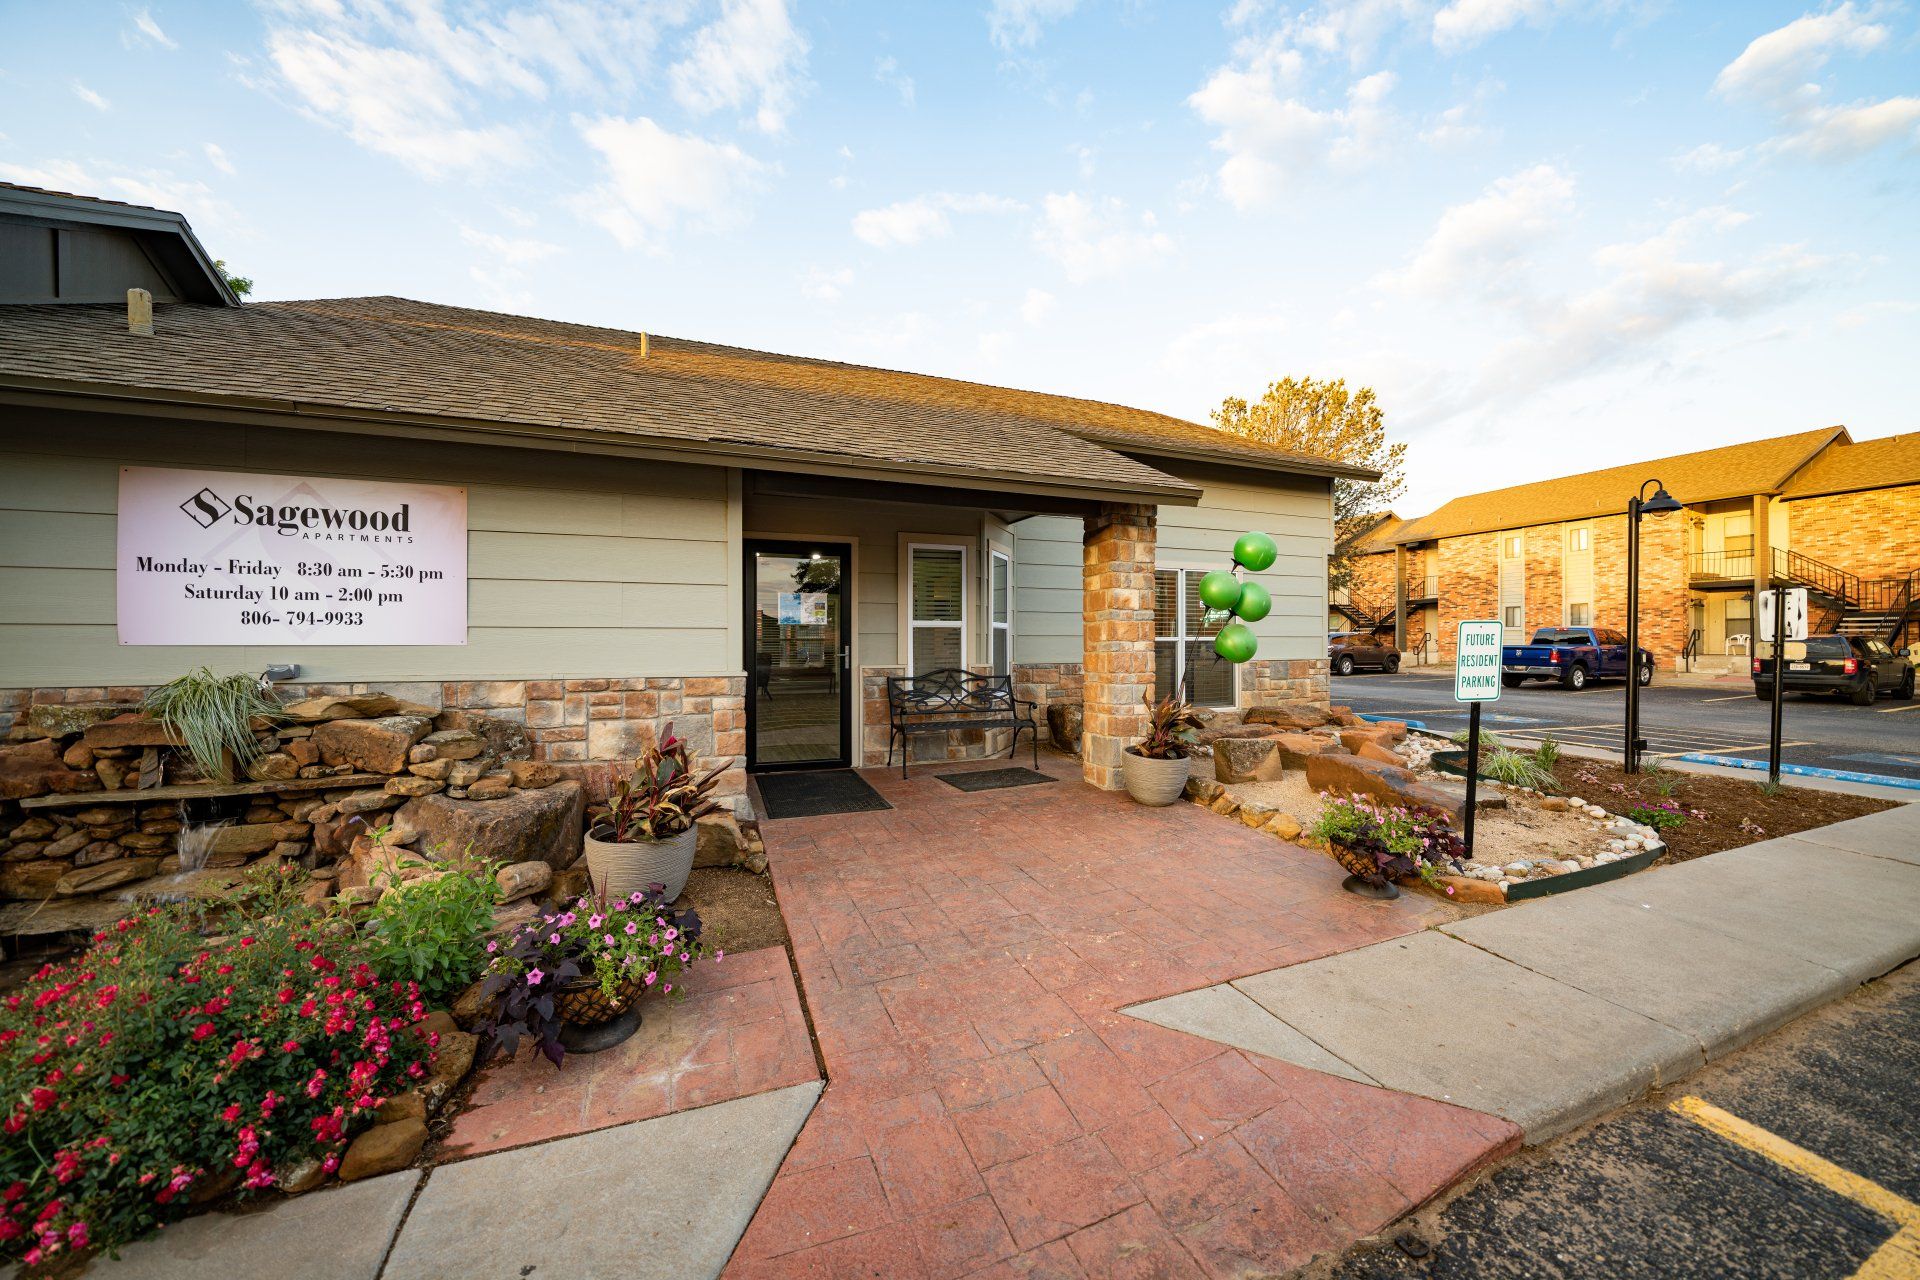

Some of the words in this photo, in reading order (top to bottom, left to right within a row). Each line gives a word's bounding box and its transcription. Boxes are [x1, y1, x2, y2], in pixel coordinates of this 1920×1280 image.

[234, 495, 411, 536] Sagewood
[303, 532, 413, 544] APARTMENTS
[136, 557, 208, 577] Monday
[230, 560, 281, 579] Friday
[298, 562, 332, 576] 8:30
[338, 568, 362, 577] am
[381, 565, 413, 578] 5:30
[419, 571, 442, 583] pm
[185, 584, 263, 604] Saturday
[271, 586, 288, 600] 10
[295, 592, 319, 600] am
[339, 588, 372, 601] 2:00
[378, 594, 402, 606] pm
[287, 612, 363, 625] 794-9933
[1466, 634, 1495, 645] FUTURE
[1461, 655, 1498, 667] RESIDENT
[1462, 675, 1495, 687] PARKING
